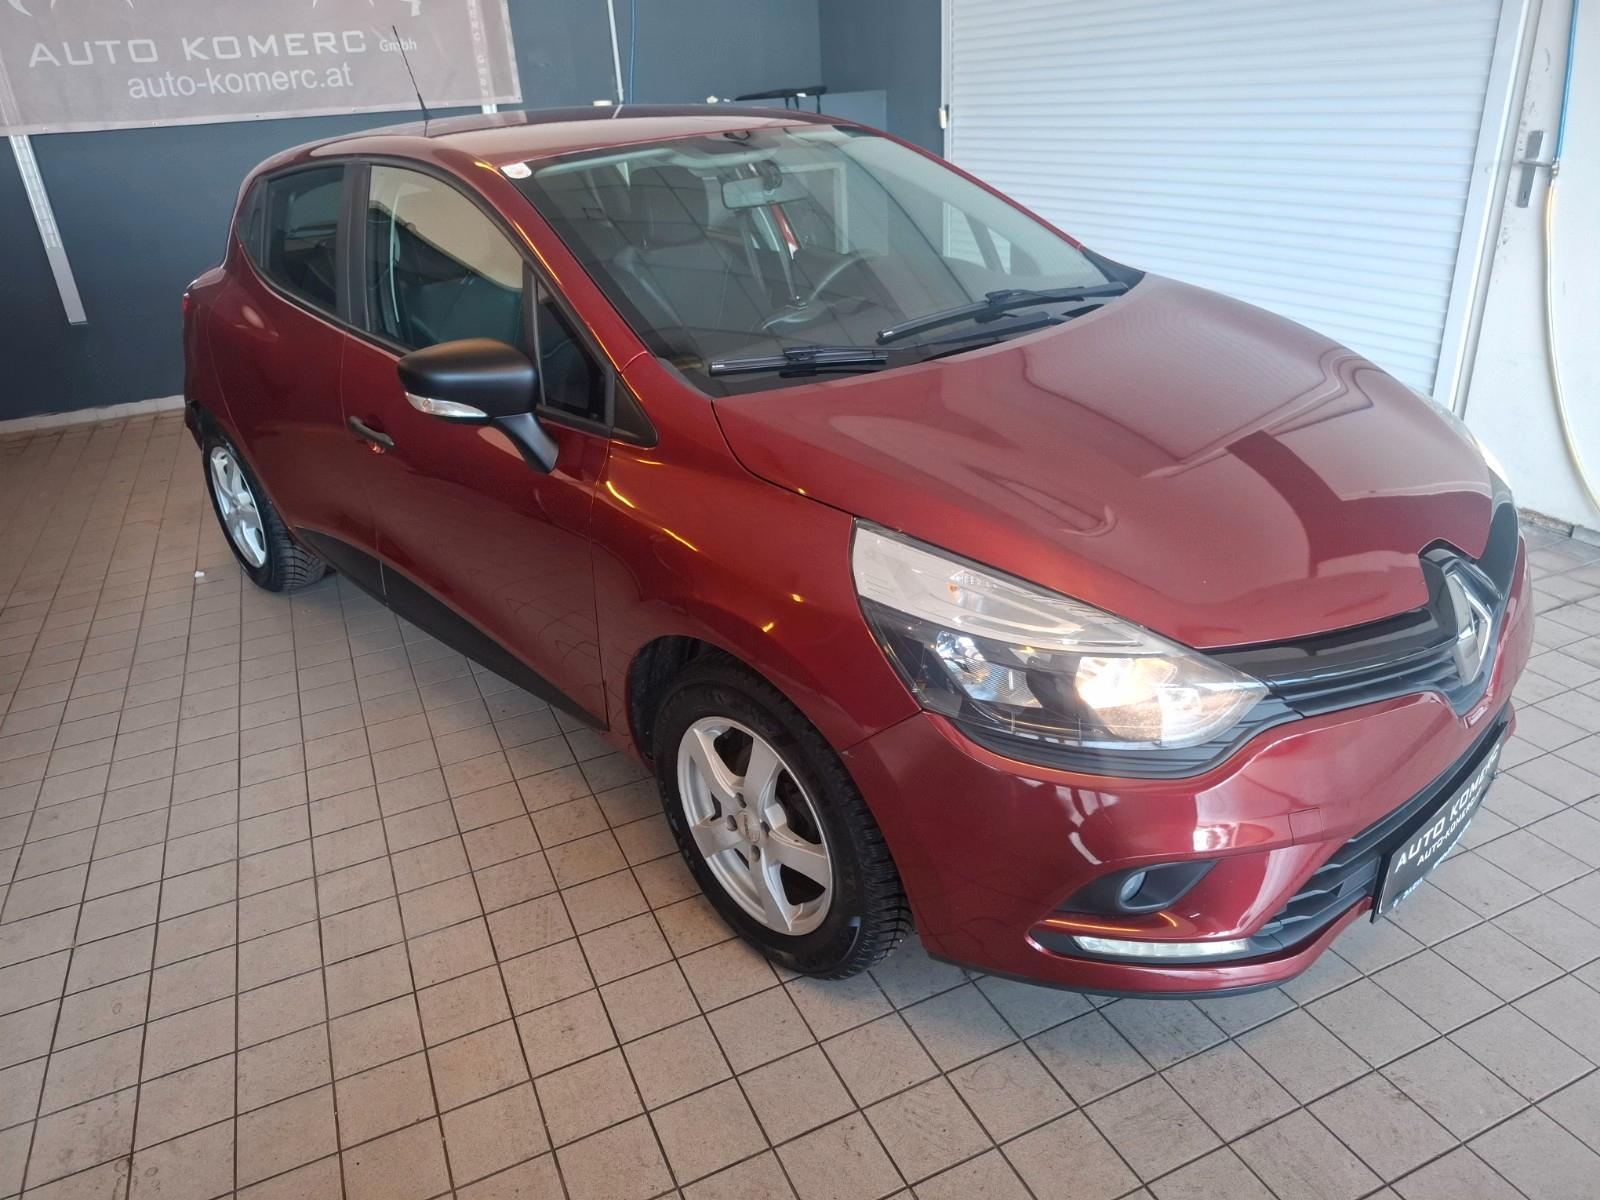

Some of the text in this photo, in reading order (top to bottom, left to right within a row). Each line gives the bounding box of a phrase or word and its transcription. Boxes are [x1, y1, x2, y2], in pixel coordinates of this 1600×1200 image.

[28, 39, 159, 68] AUTO
[183, 30, 367, 61] KOMERC
[127, 62, 354, 100] auto-komerc.at
[1394, 816, 1446, 873] AUTO
